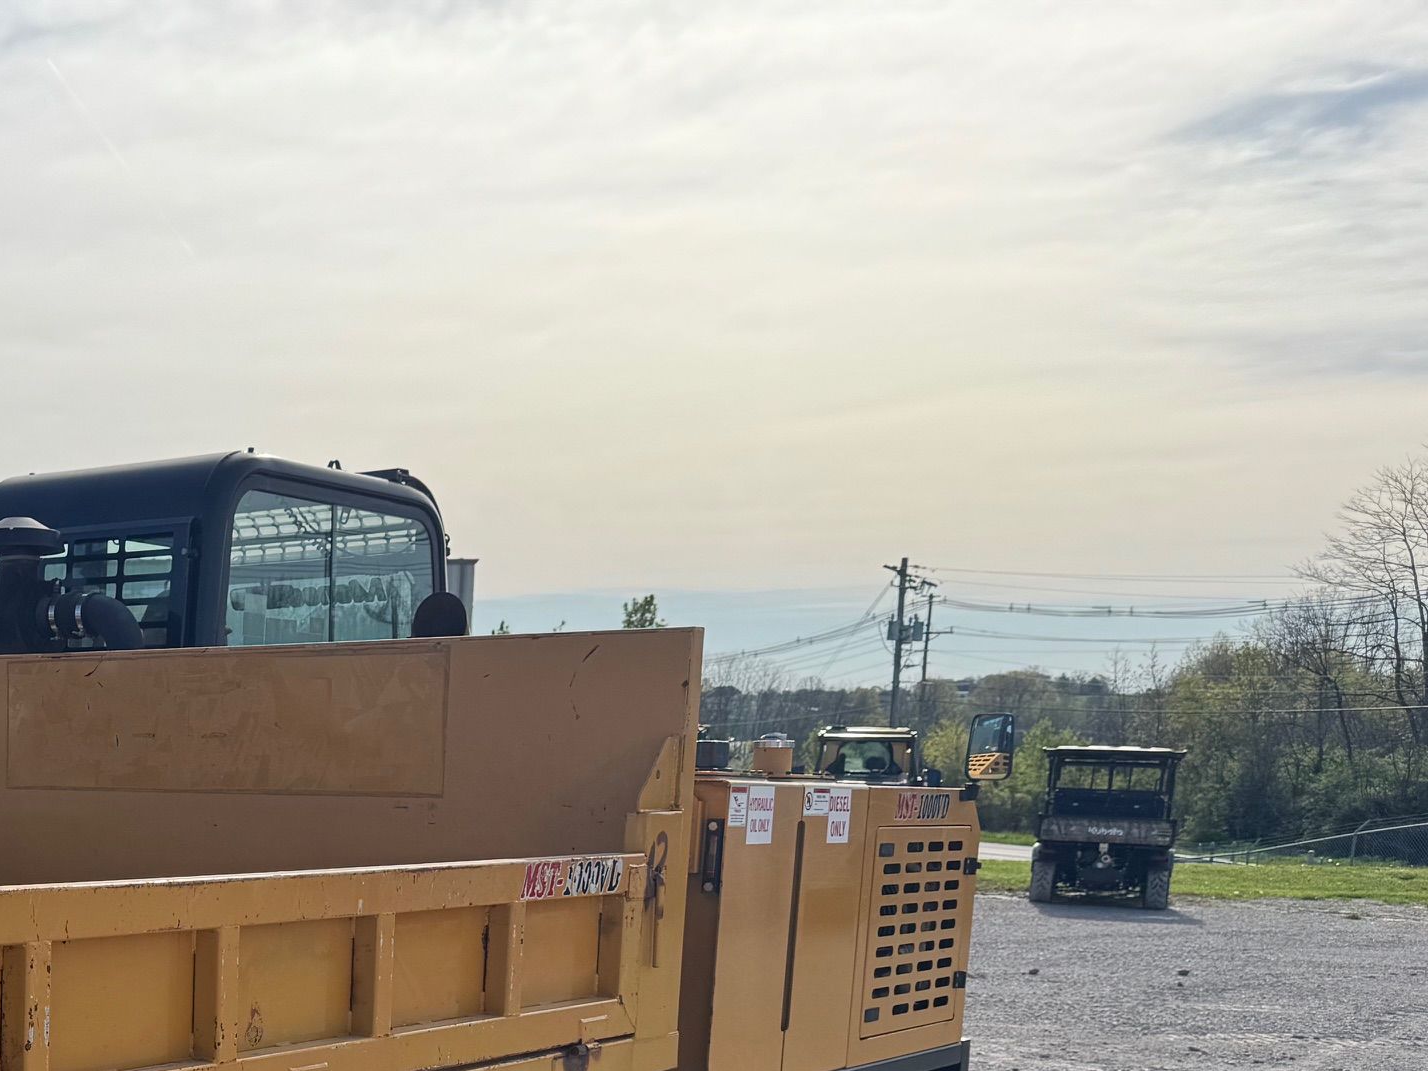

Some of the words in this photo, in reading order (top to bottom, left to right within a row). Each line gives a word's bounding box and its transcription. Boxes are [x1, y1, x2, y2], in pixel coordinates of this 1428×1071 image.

[829, 796, 850, 812] DIESEL
[830, 820, 846, 837] ONLY
[1087, 826, 1124, 836] Kubota
